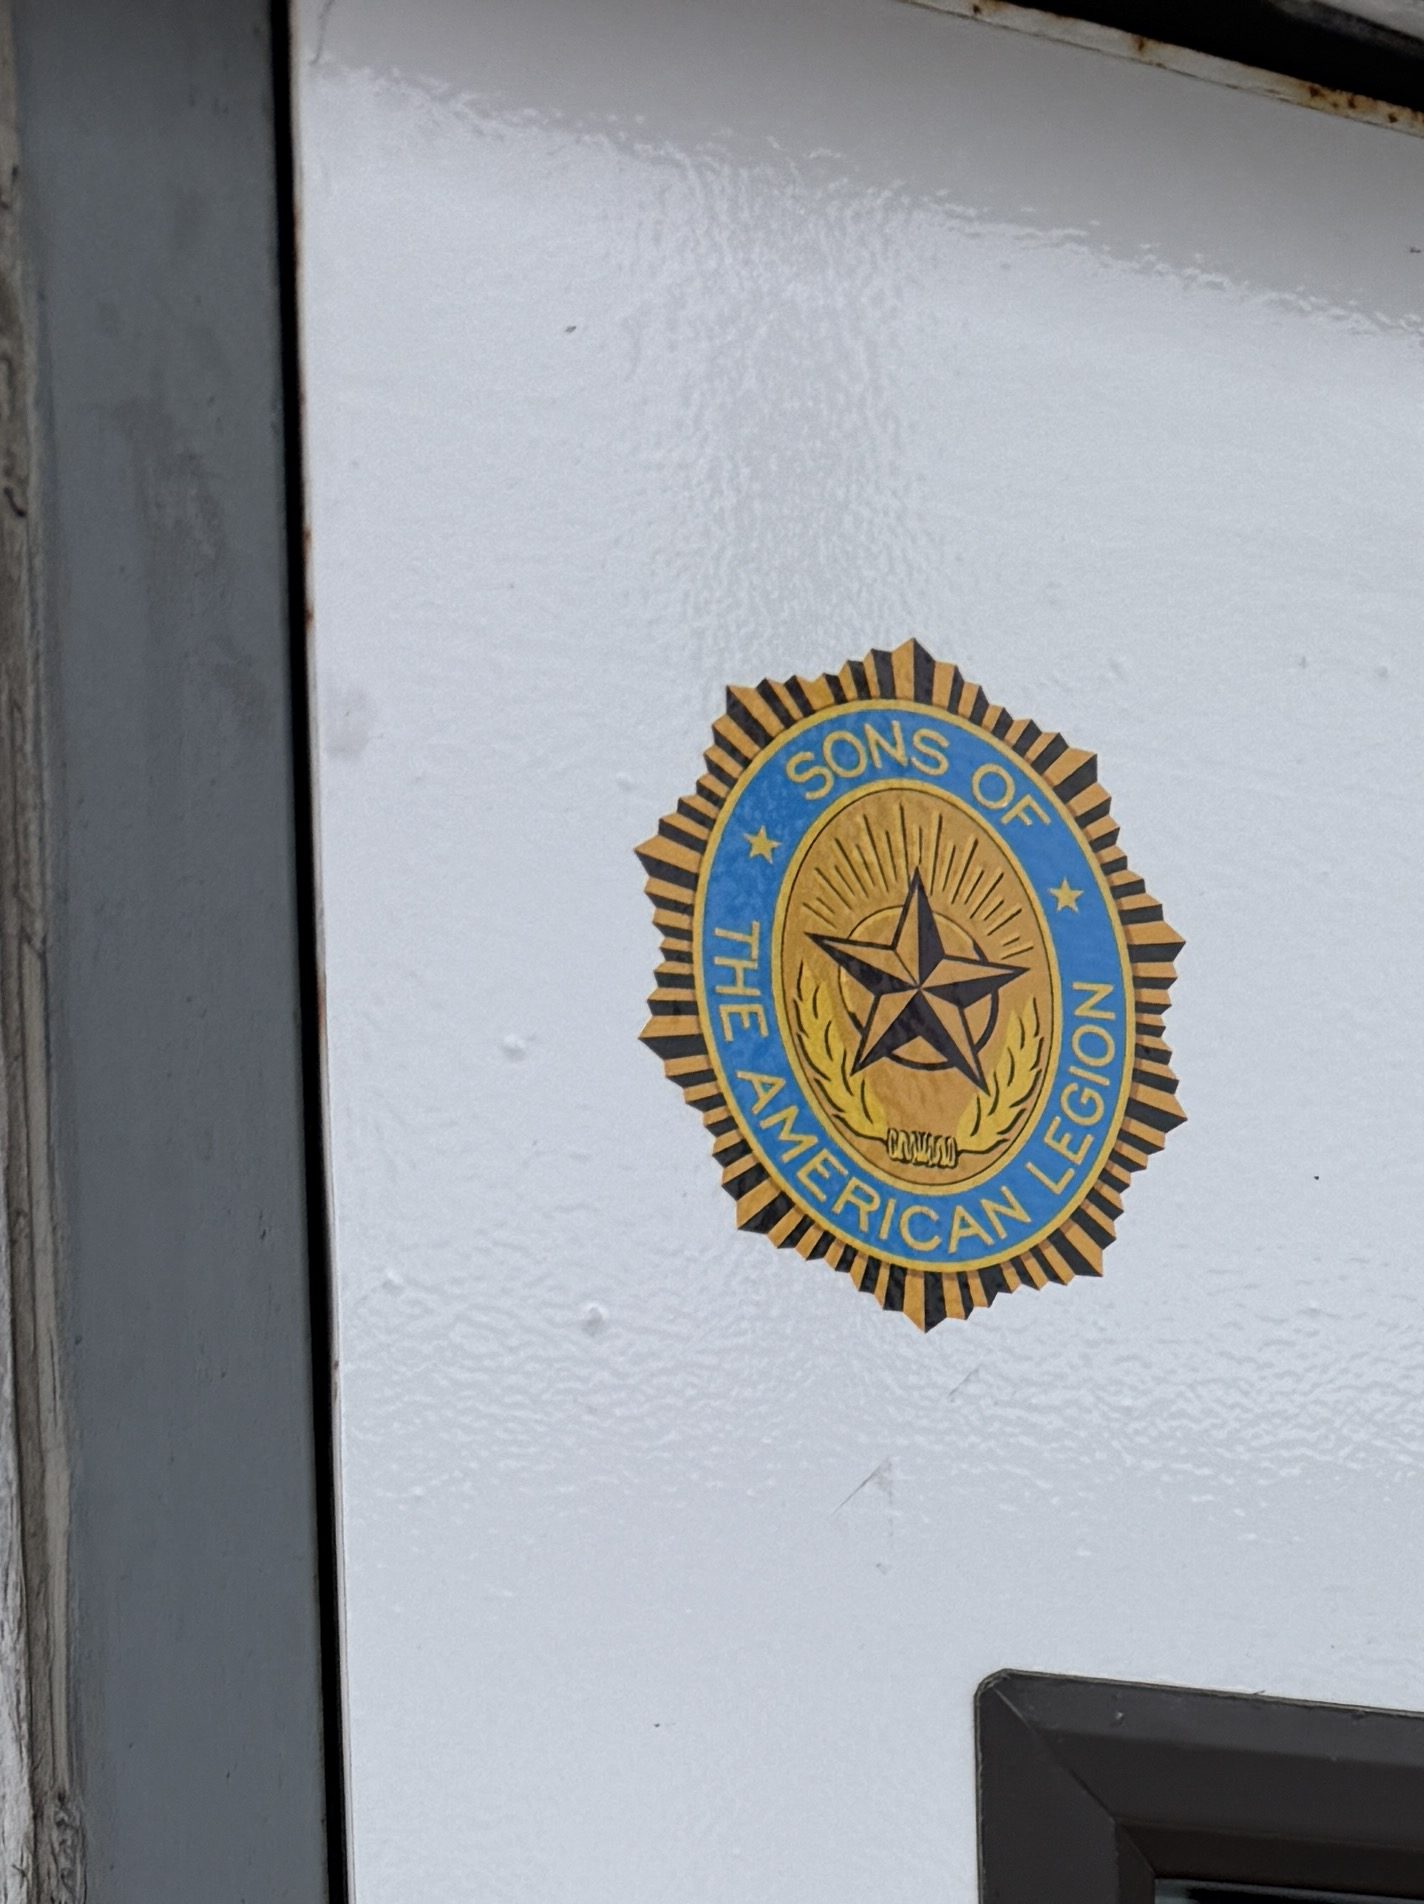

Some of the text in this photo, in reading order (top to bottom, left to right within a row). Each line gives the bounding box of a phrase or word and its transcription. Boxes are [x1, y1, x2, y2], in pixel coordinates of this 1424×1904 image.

[786, 720, 1051, 829] SONS OF
[713, 921, 1115, 1254] THE AMERICAN LEGION
